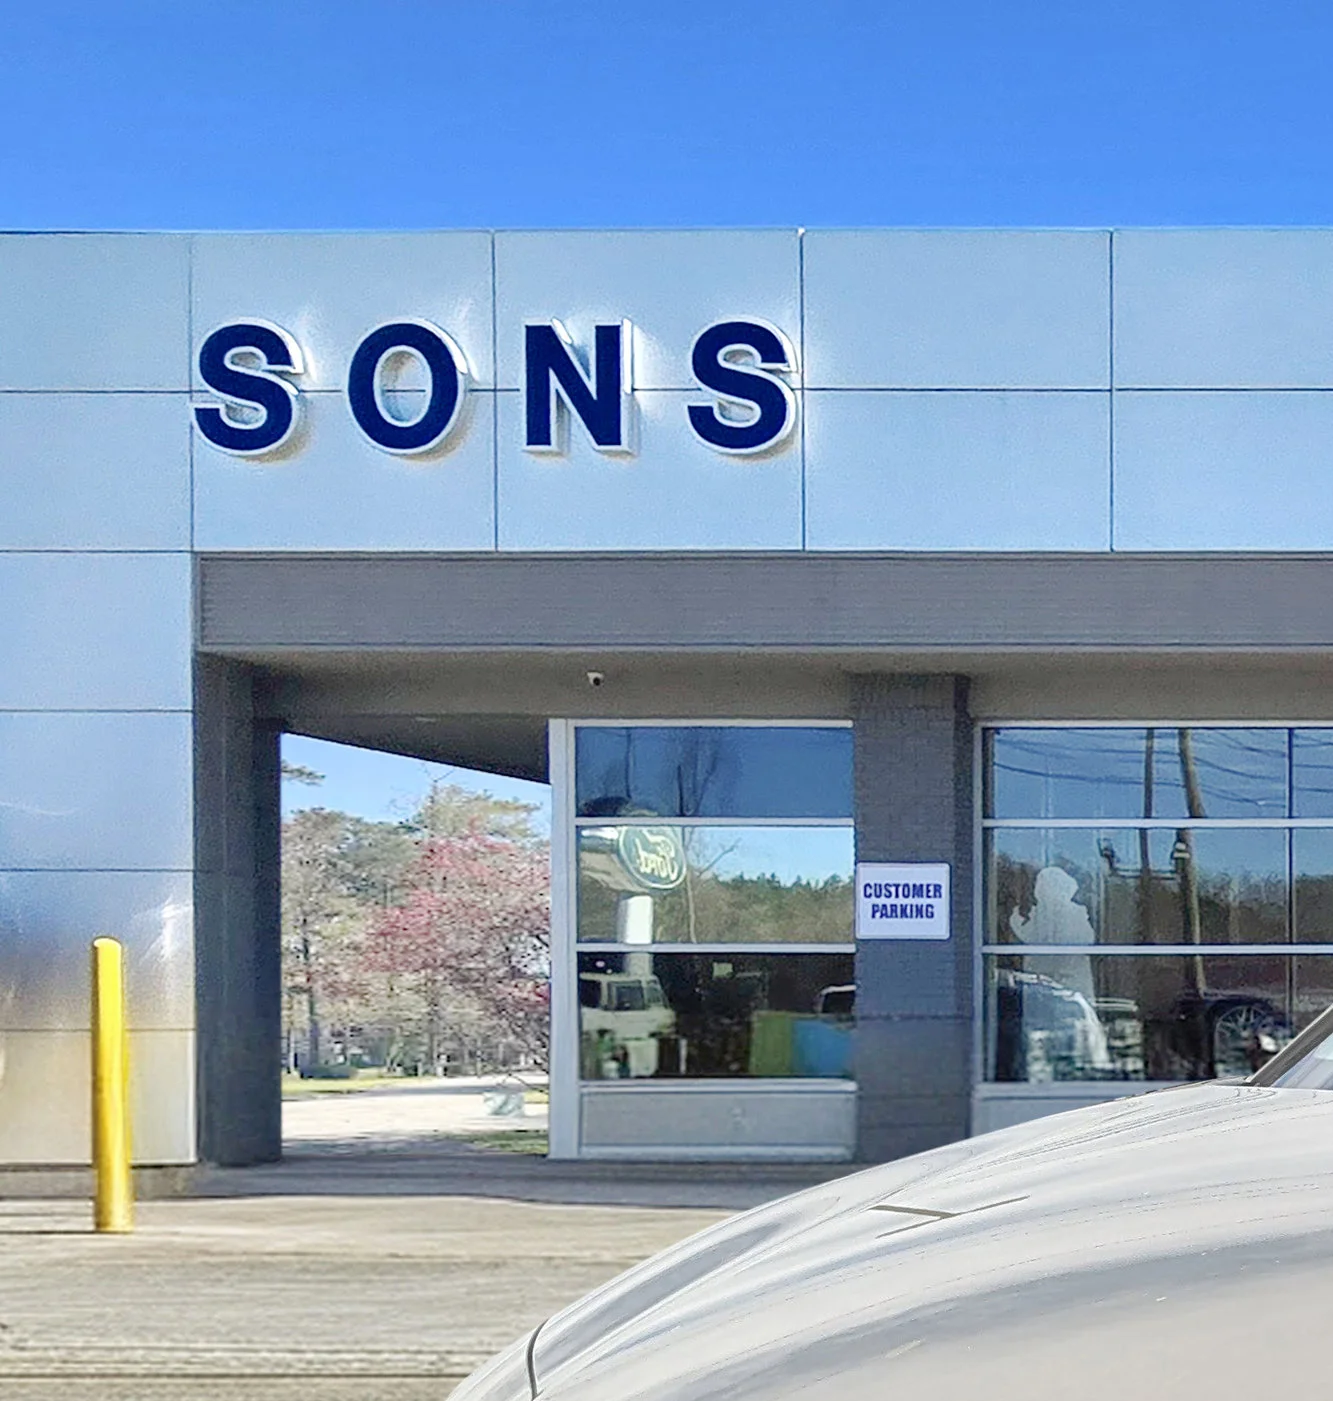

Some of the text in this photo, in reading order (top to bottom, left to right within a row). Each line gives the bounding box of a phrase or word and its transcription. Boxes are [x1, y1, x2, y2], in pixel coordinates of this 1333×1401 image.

[192, 318, 798, 456] SONS
[863, 882, 943, 899] CUSTOMER
[871, 903, 935, 919] PARKING
